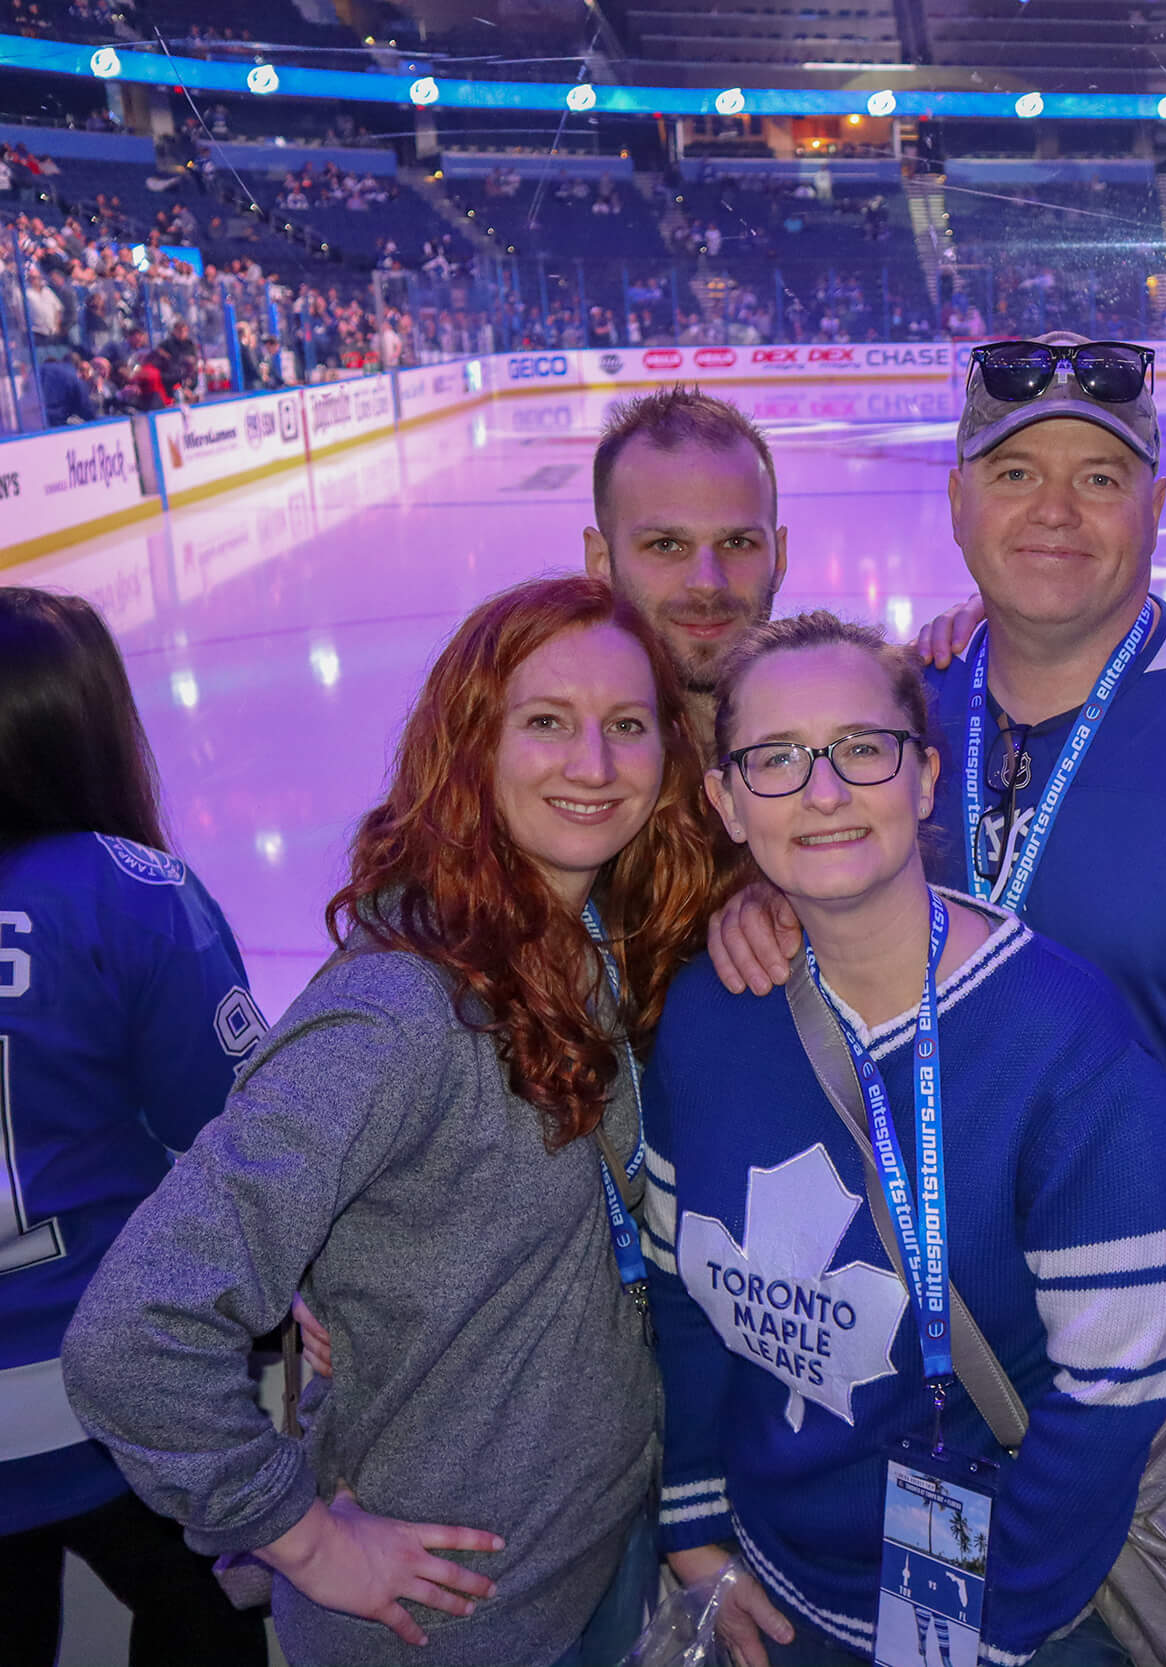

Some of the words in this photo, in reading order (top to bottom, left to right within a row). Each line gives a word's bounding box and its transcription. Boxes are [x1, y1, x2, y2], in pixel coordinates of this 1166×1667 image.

[509, 356, 567, 379] GEICO
[752, 348, 799, 363] DEX
[808, 347, 855, 362] DEX
[866, 349, 949, 366] CHASE
[65, 444, 97, 489] Hard
[97, 440, 128, 488] Rock
[1001, 724, 1091, 913] litesportstours.ca
[919, 1066, 945, 1312] elitesportstours.ca
[706, 1260, 857, 1331] TORONTO
[733, 1301, 832, 1359] MAPLE
[743, 1333, 825, 1387] LEAFS
